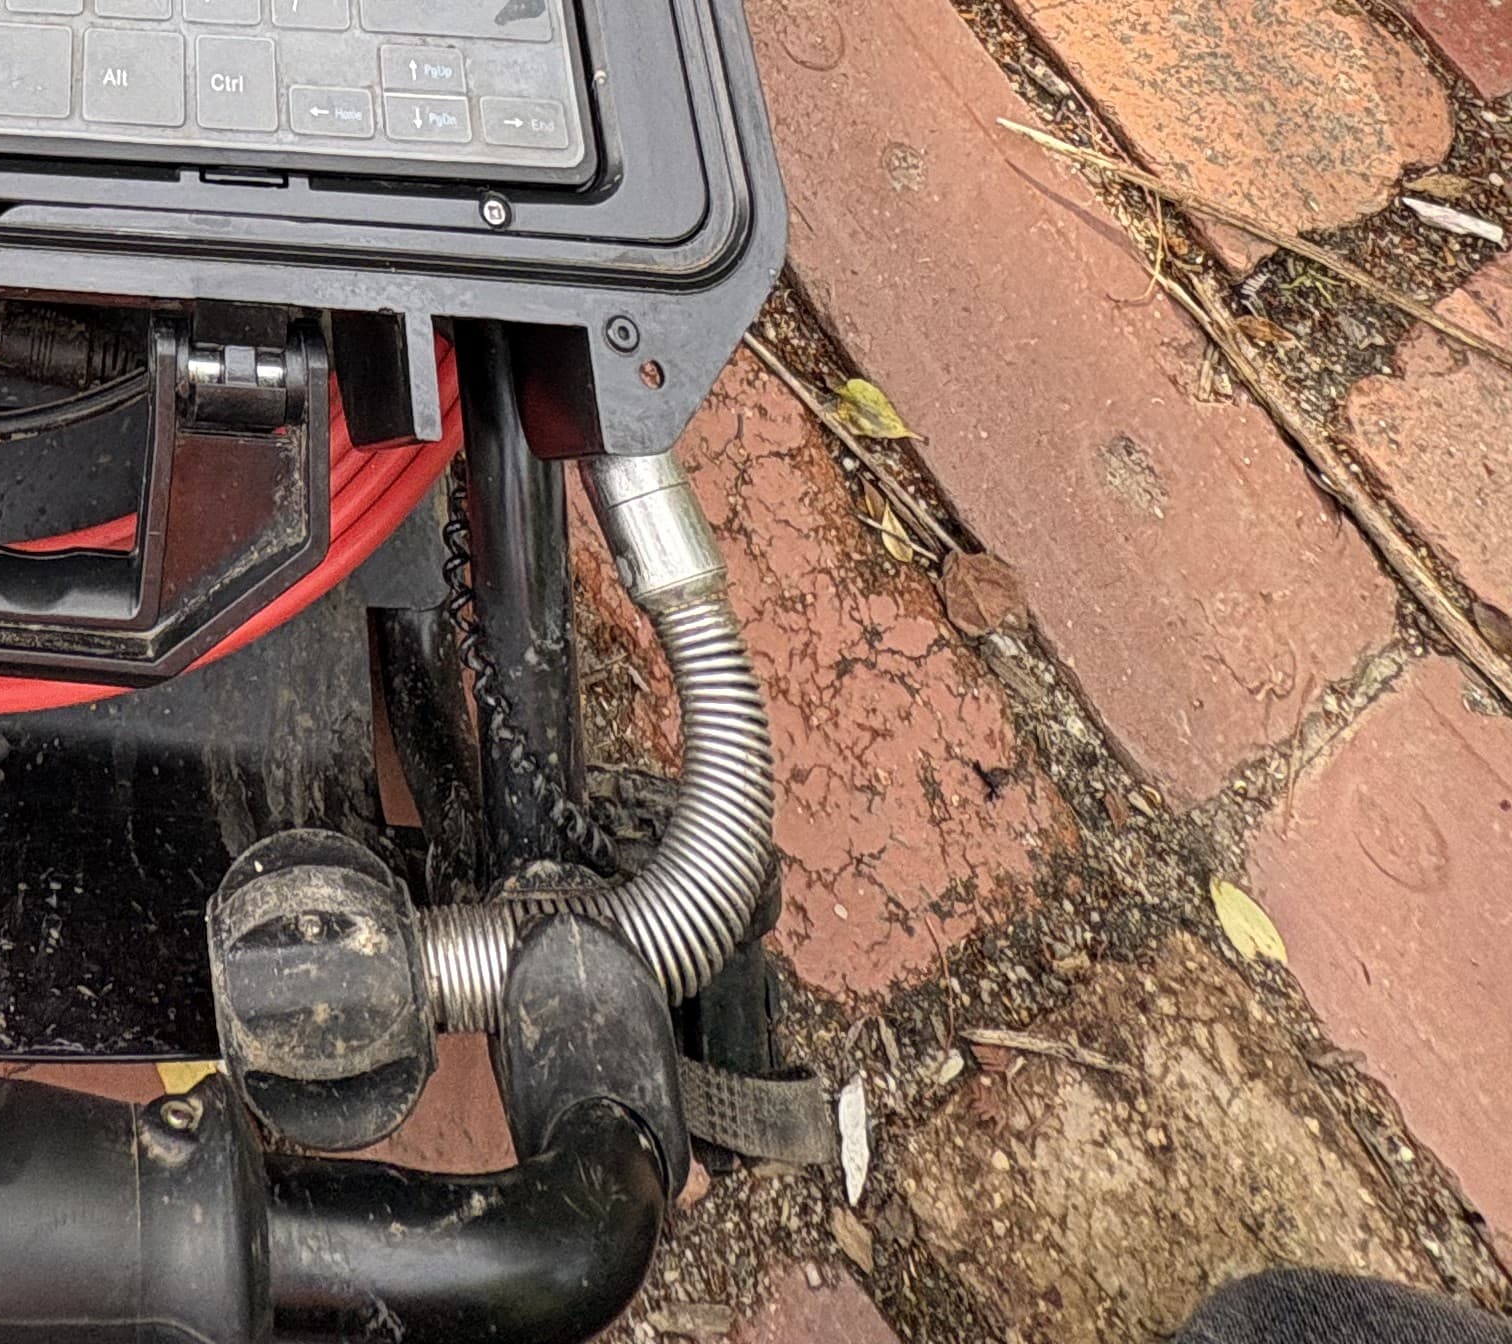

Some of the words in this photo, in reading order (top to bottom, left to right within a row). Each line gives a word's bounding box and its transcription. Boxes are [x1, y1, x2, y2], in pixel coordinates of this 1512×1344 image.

[102, 68, 129, 87] Alt
[210, 73, 244, 93] Ctrl
[531, 118, 555, 132] End
